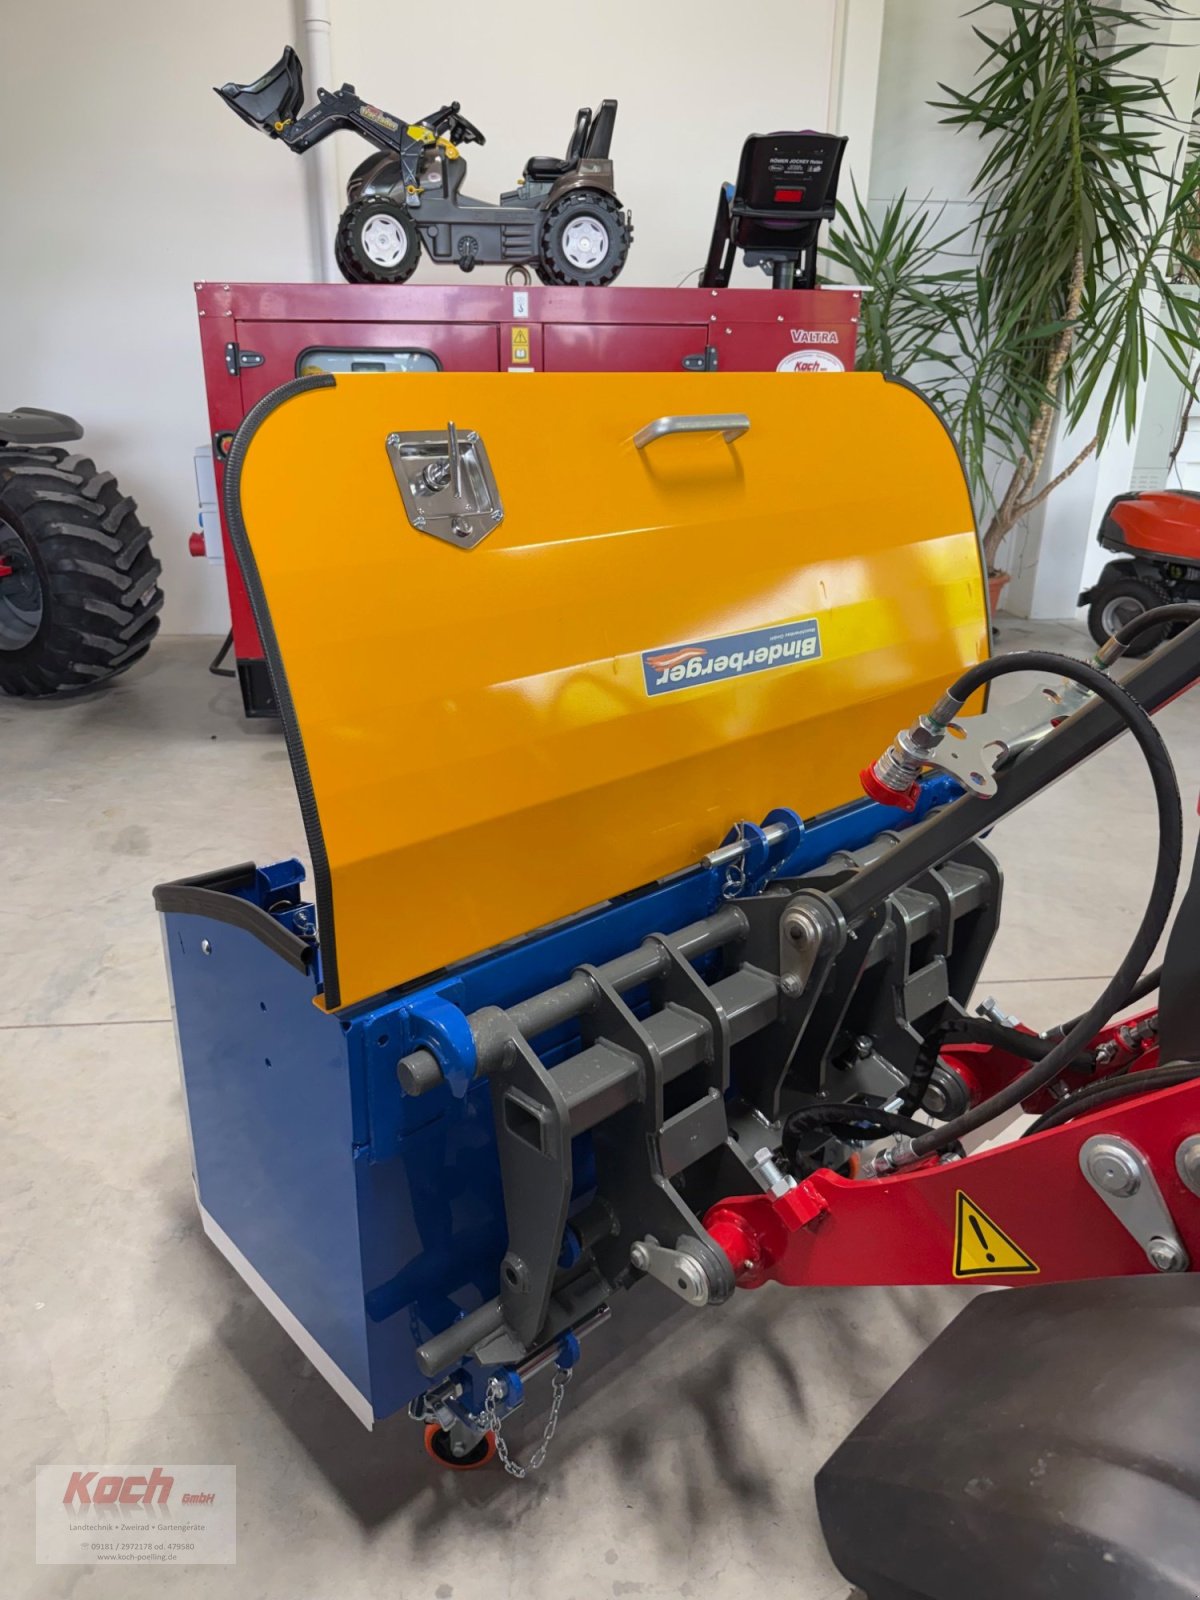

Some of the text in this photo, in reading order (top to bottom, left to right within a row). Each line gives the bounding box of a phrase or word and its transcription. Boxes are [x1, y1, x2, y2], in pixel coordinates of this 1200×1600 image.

[790, 329, 839, 344] VALTRA
[794, 361, 820, 372] Koch
[656, 637, 817, 685] Binderberger
